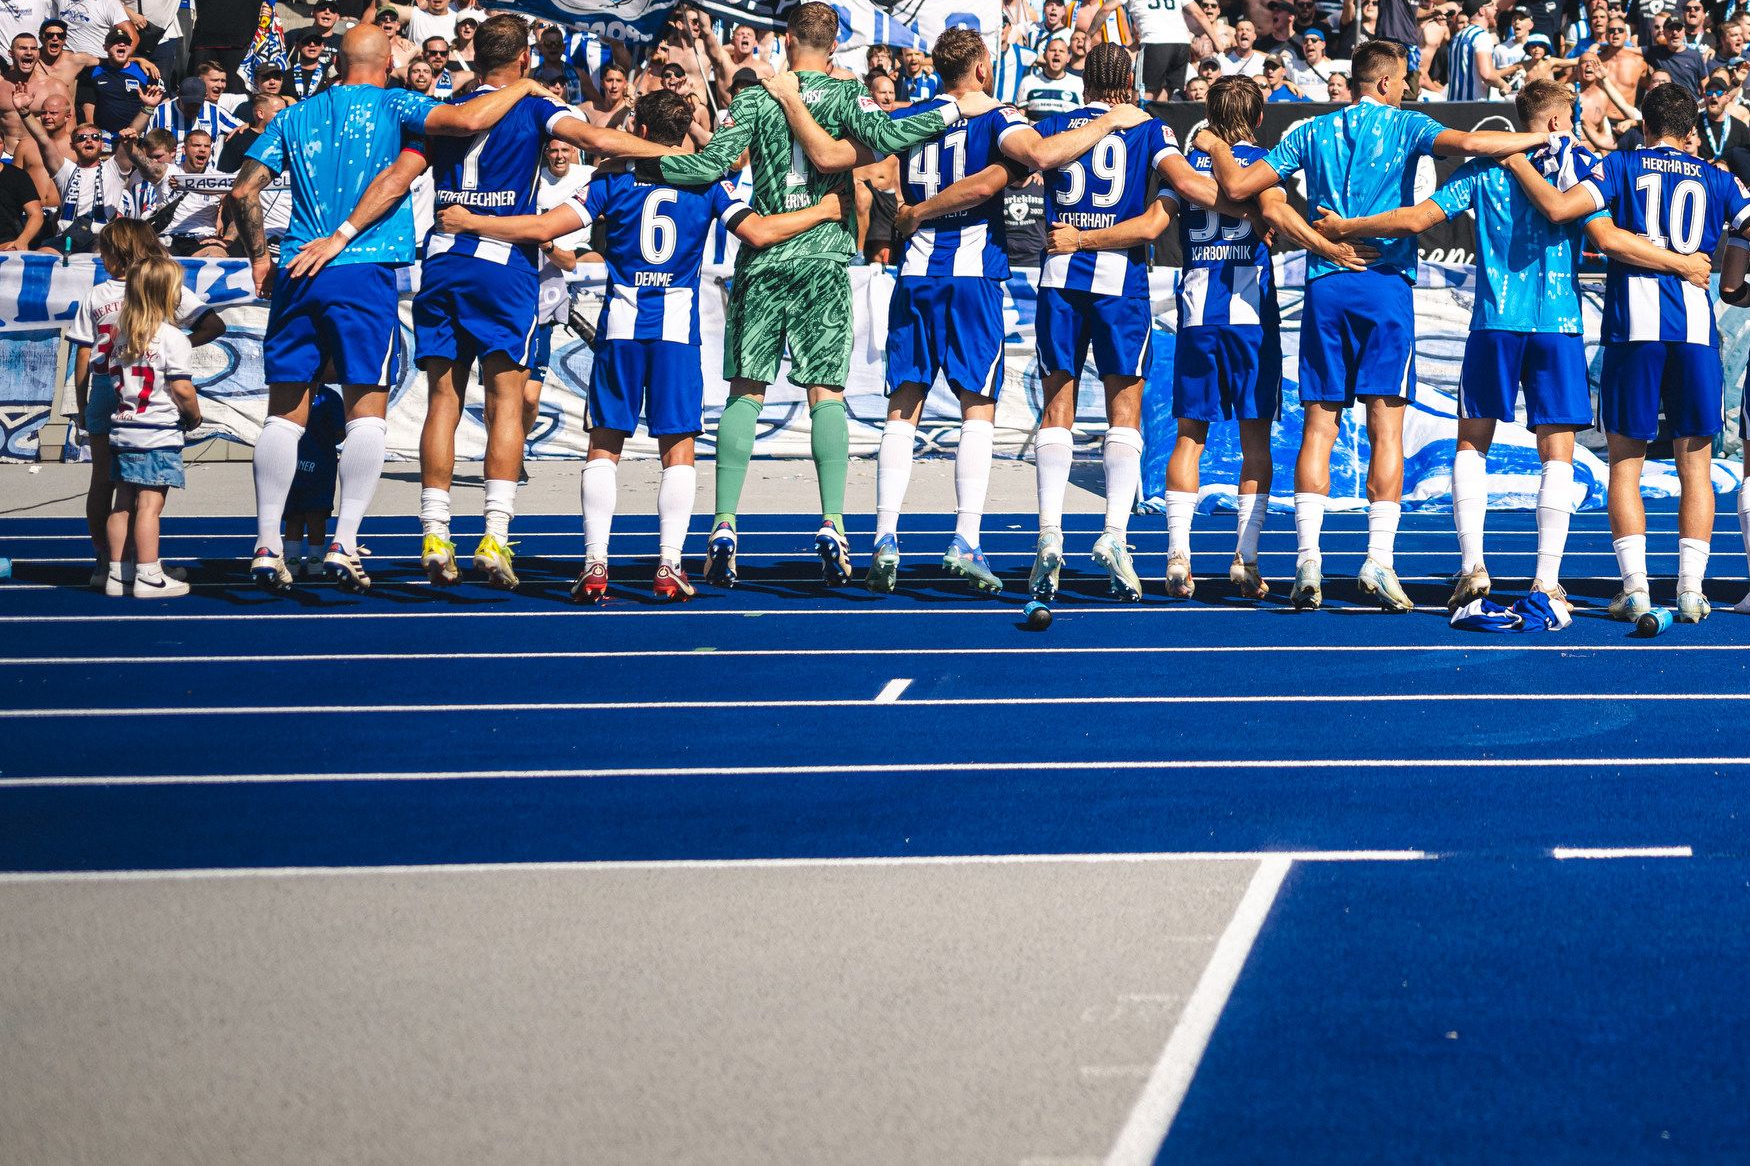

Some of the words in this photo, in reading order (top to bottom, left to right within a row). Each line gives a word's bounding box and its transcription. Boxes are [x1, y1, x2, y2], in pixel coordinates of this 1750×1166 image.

[908, 129, 968, 201] 41
[1641, 157, 1683, 175] HERTHA
[1683, 159, 1702, 178] BSC
[184, 177, 235, 189] RAGAZ
[1059, 211, 1117, 229] SCHERHANT
[1636, 172, 1707, 255] 10
[641, 188, 678, 265] 6
[1191, 245, 1252, 261] KARBOWNIK
[634, 271, 674, 288] DEMME
